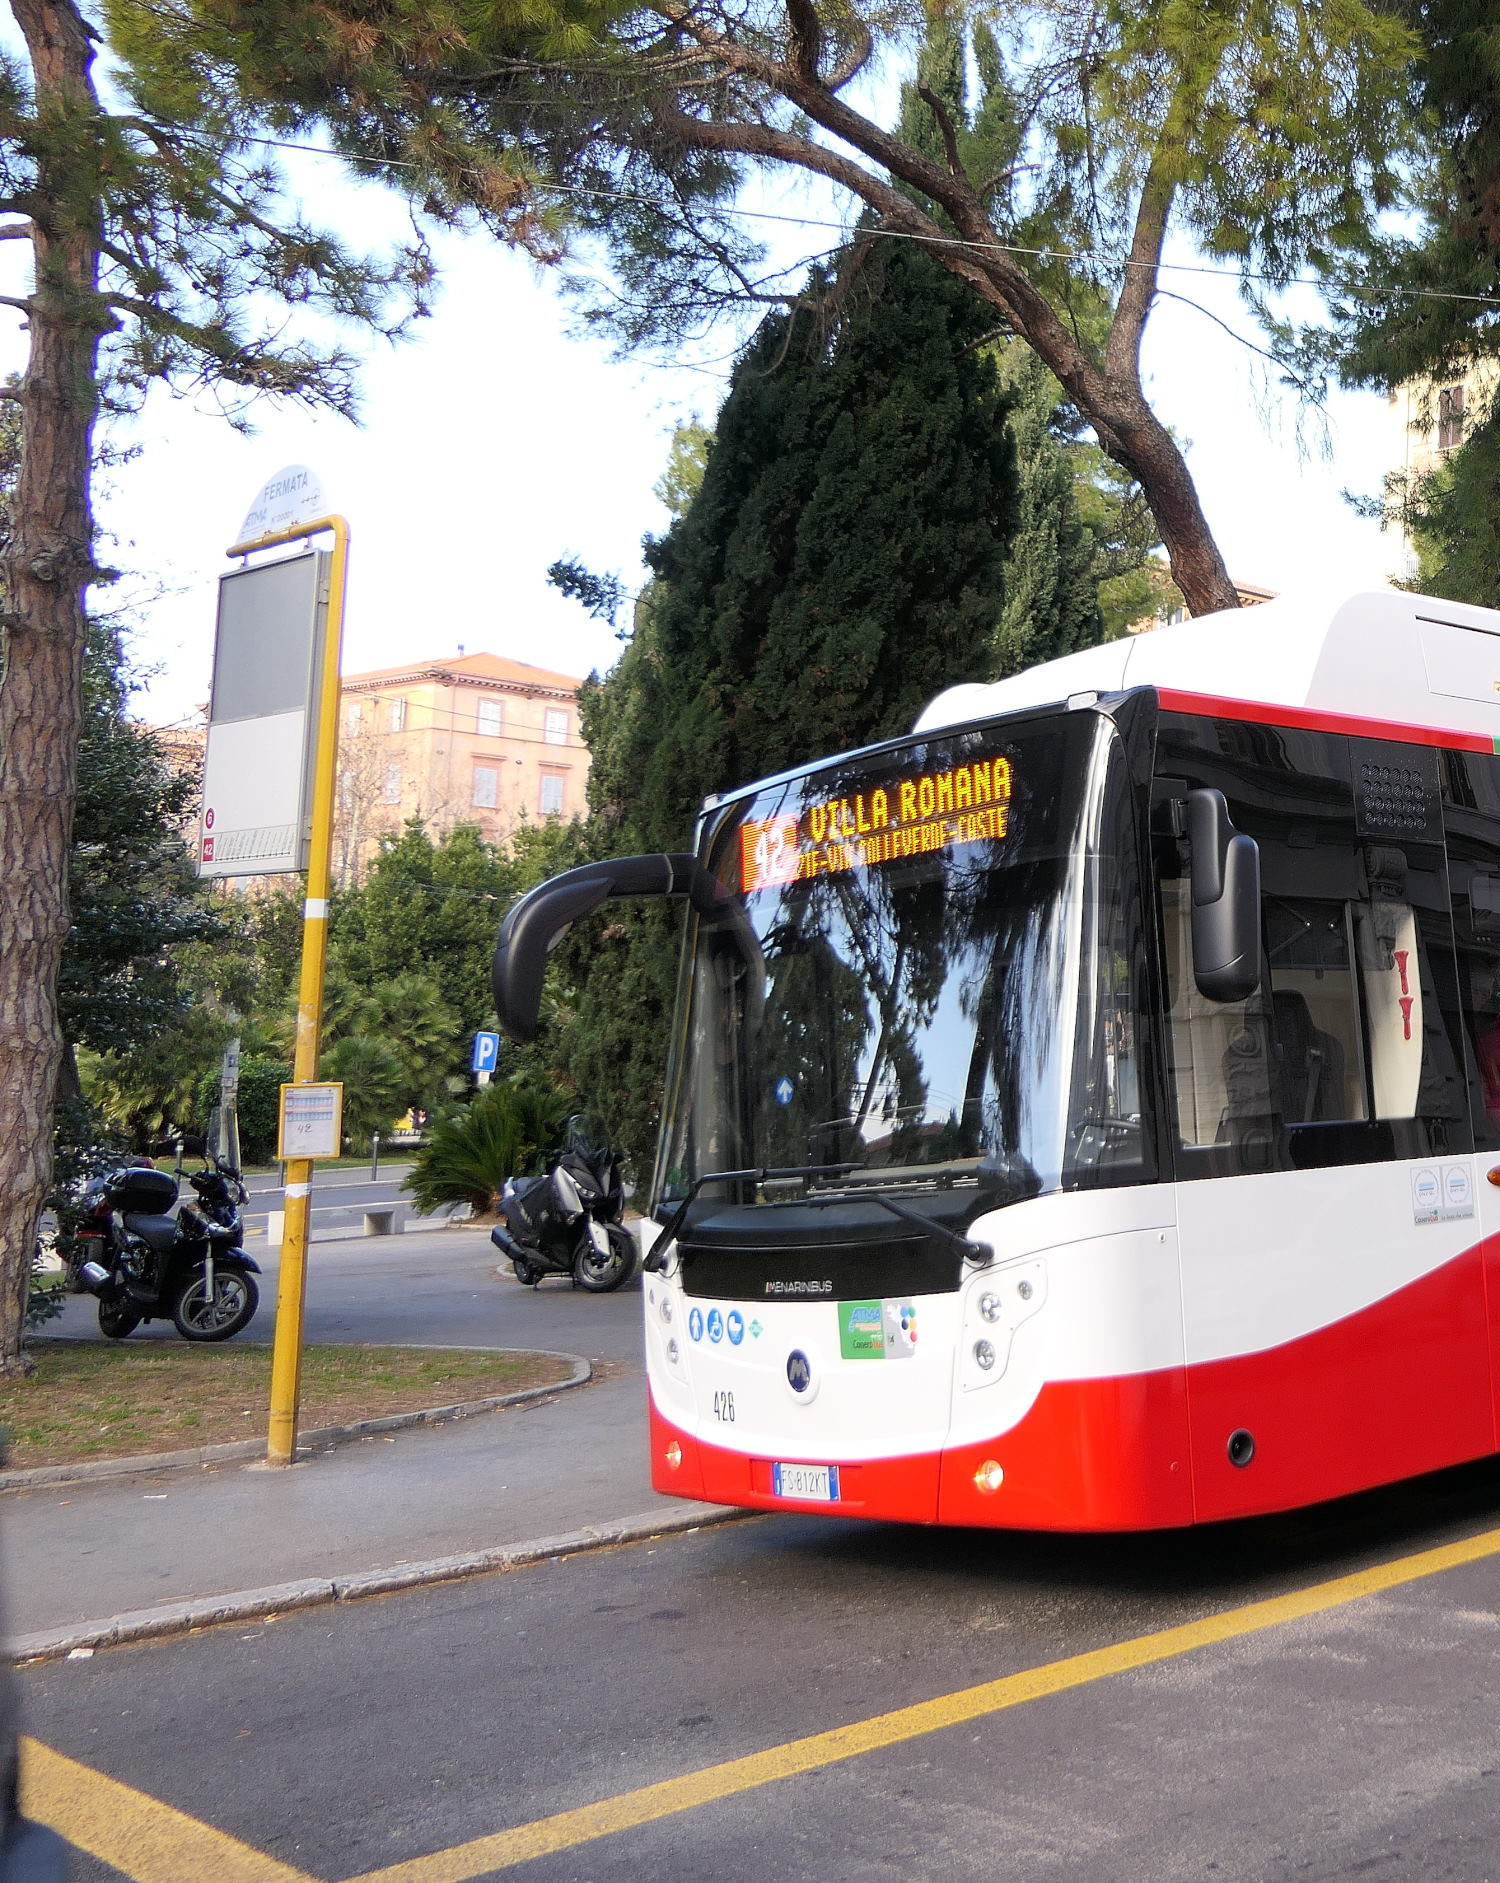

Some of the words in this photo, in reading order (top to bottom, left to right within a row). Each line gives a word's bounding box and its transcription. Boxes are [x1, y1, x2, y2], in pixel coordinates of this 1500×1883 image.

[264, 471, 309, 503] FERMATA
[810, 789, 889, 841] VILLA
[900, 757, 1011, 822] ROMANA
[207, 813, 213, 825] 6
[203, 843, 213, 856] 42
[754, 826, 787, 881] 42
[479, 1036, 494, 1067] P
[713, 1390, 735, 1422] 426
